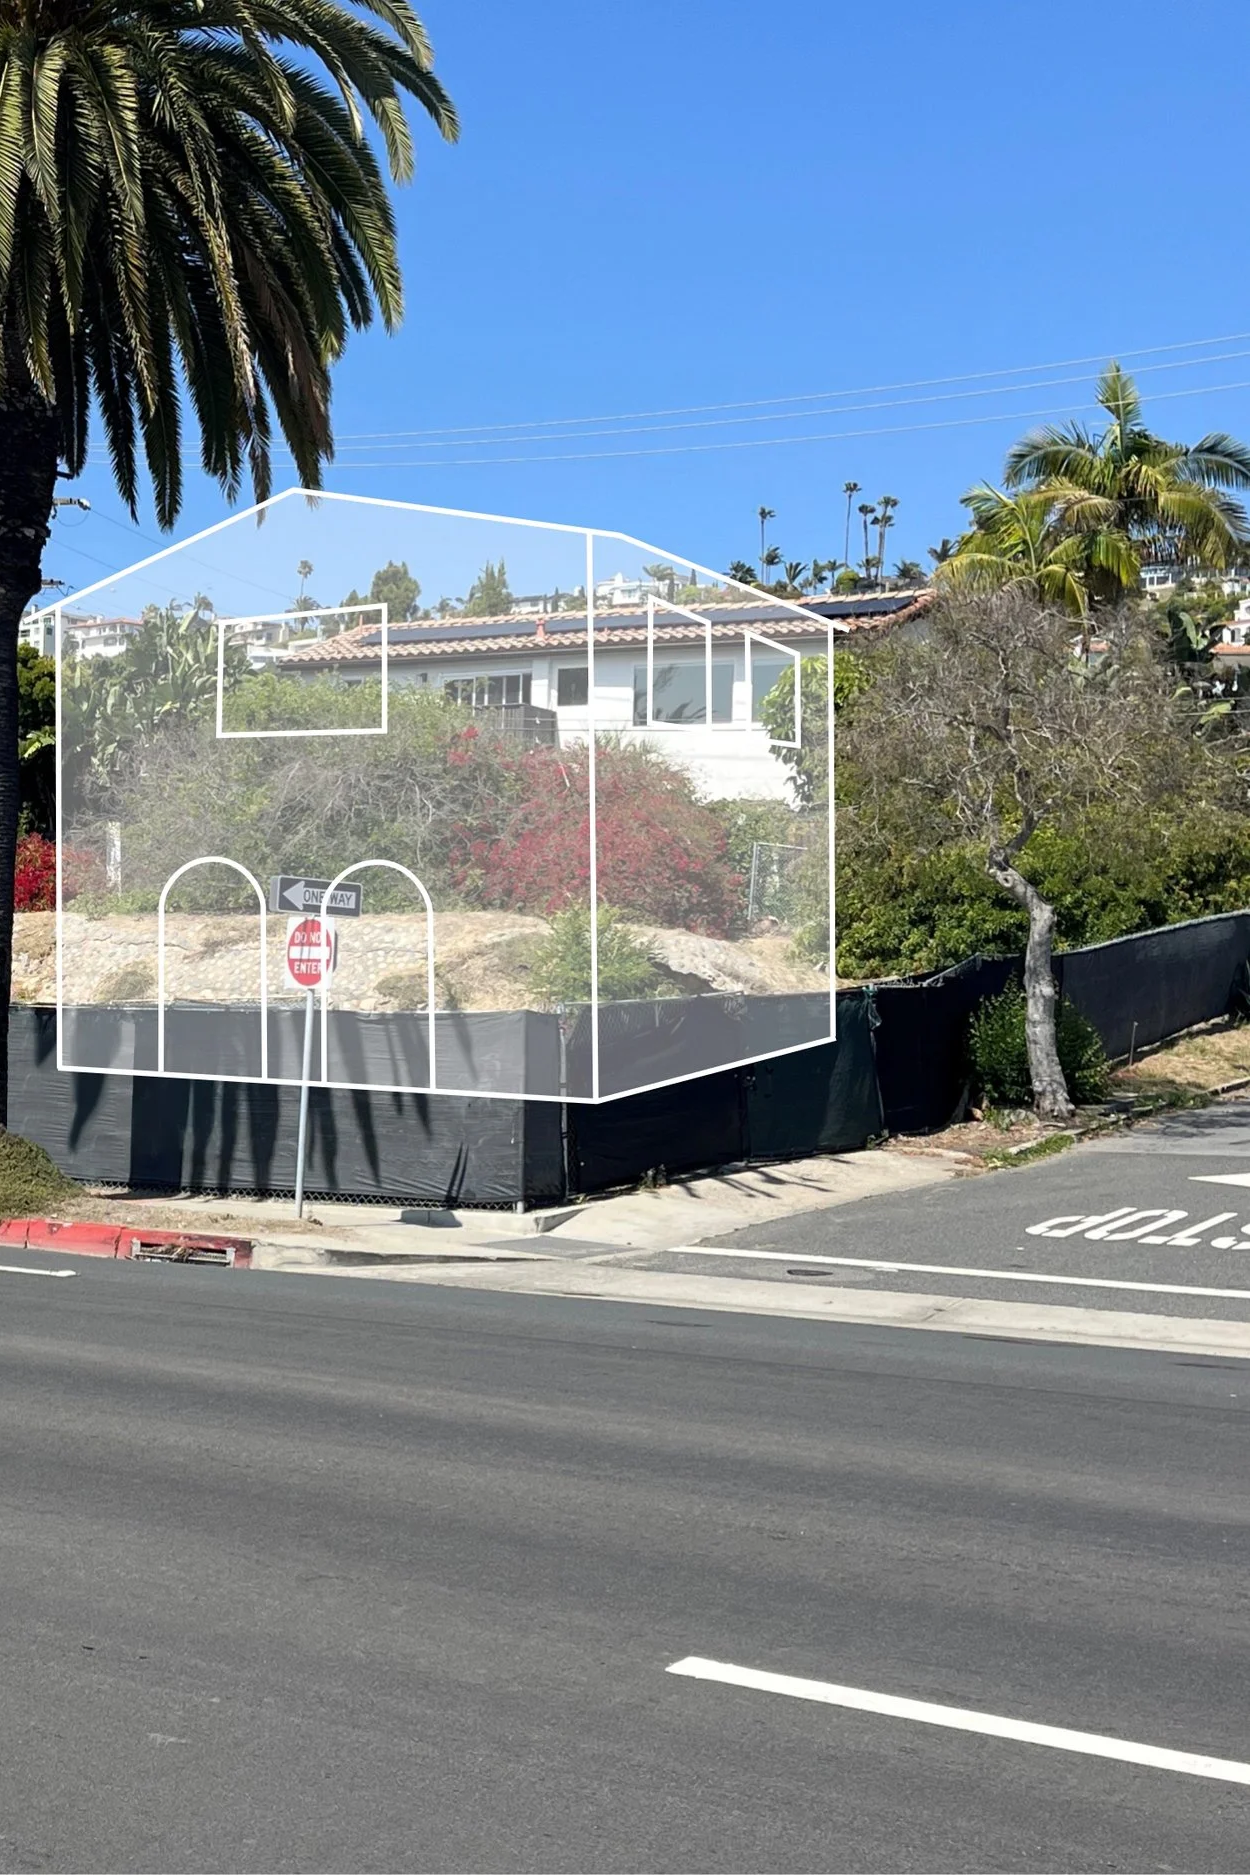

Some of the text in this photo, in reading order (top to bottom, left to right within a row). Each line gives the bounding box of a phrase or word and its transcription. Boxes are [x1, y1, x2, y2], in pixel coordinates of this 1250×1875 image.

[303, 889, 353, 907] ONE WAY
[294, 931, 324, 944] DO NO
